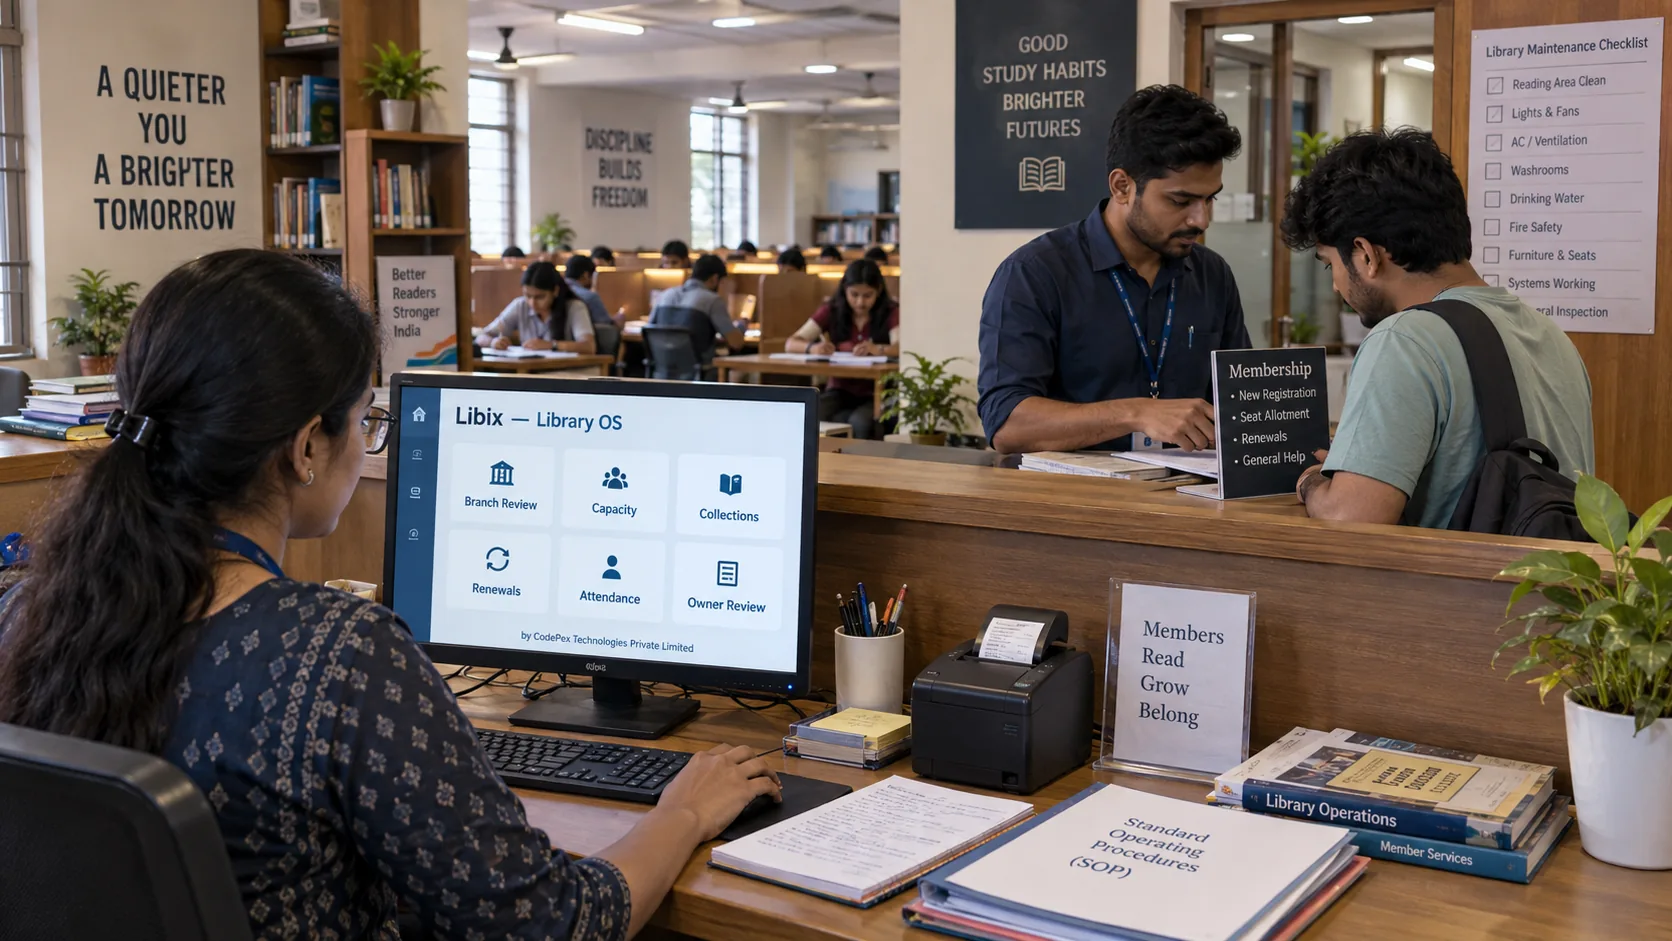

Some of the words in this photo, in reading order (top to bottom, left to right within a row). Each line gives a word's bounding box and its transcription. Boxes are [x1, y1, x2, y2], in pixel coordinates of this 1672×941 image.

[1019, 33, 1068, 53] GOOD
[1486, 46, 1524, 58] Library
[1527, 42, 1596, 56] Maintenance
[1599, 36, 1649, 51] Checklist
[983, 63, 1037, 84] STUDY
[1043, 59, 1107, 80] HABITS
[97, 65, 113, 98] A
[124, 67, 226, 106] QUIETER
[1513, 78, 1552, 91] Reading
[1554, 76, 1576, 88] Area
[1578, 75, 1606, 86] Clean
[1003, 89, 1085, 111] BRIGHTER
[1512, 107, 1543, 121] Lights
[1545, 107, 1553, 117] &
[1556, 106, 1580, 117] Fans
[138, 112, 187, 145] YOU
[1006, 118, 1081, 139] FUTURES
[1511, 136, 1525, 147] AC
[1527, 136, 1533, 148] /
[1535, 134, 1588, 146] Ventilation
[94, 153, 111, 185] A
[599, 157, 642, 181] BUILDS
[1511, 165, 1569, 176] Washrooms
[592, 185, 649, 209] FREEDOM
[1510, 193, 1551, 206] Drinking
[1554, 193, 1585, 203] Water
[93, 197, 236, 231] TOMORROW
[1509, 222, 1529, 233] Fire
[1531, 221, 1563, 235] Safety
[1508, 249, 1554, 261] Furniture
[1557, 250, 1565, 260] &
[1568, 250, 1597, 261] Seats
[392, 267, 426, 281] Better
[393, 286, 437, 300] Readers
[1508, 277, 1551, 290] Systems
[1553, 278, 1596, 292] Working
[393, 306, 440, 321] Stronger
[1556, 306, 1609, 320] Inspection
[394, 324, 421, 338] India
[1229, 361, 1312, 379] Membership
[1239, 389, 1261, 401] New
[1263, 386, 1317, 402] Registration
[456, 406, 503, 427] Libix
[537, 411, 594, 433] Library
[599, 414, 623, 431] OS
[1240, 411, 1262, 423] Seat
[1264, 408, 1310, 422] Allotment
[1241, 430, 1288, 445] Renewals
[1242, 451, 1281, 467] General
[1283, 450, 1306, 465] Help
[465, 496, 499, 508] Branch
[501, 498, 538, 511] Review
[592, 502, 638, 518] Capacity
[699, 508, 760, 522] Collections
[472, 582, 521, 597] Renewals
[579, 590, 641, 605] Attendance
[687, 597, 724, 610] Owner
[726, 600, 766, 613] Review
[1143, 620, 1225, 645] Members
[521, 631, 532, 642] by
[533, 632, 571, 644] CodePex
[573, 635, 628, 649] Technologies
[630, 639, 660, 650] Private
[662, 642, 694, 653] Limited
[1141, 647, 1185, 668] Read
[1140, 674, 1190, 696] Grow
[1138, 701, 1200, 730] Belong
[1266, 793, 1316, 818] Library
[1318, 801, 1398, 829] Operations
[1123, 817, 1211, 843] Standard
[1108, 829, 1205, 860] Operating
[1380, 840, 1425, 859] Member
[1427, 849, 1473, 866] Services
[1090, 840, 1200, 873] Procedures
[1069, 855, 1132, 880] (SOP)
